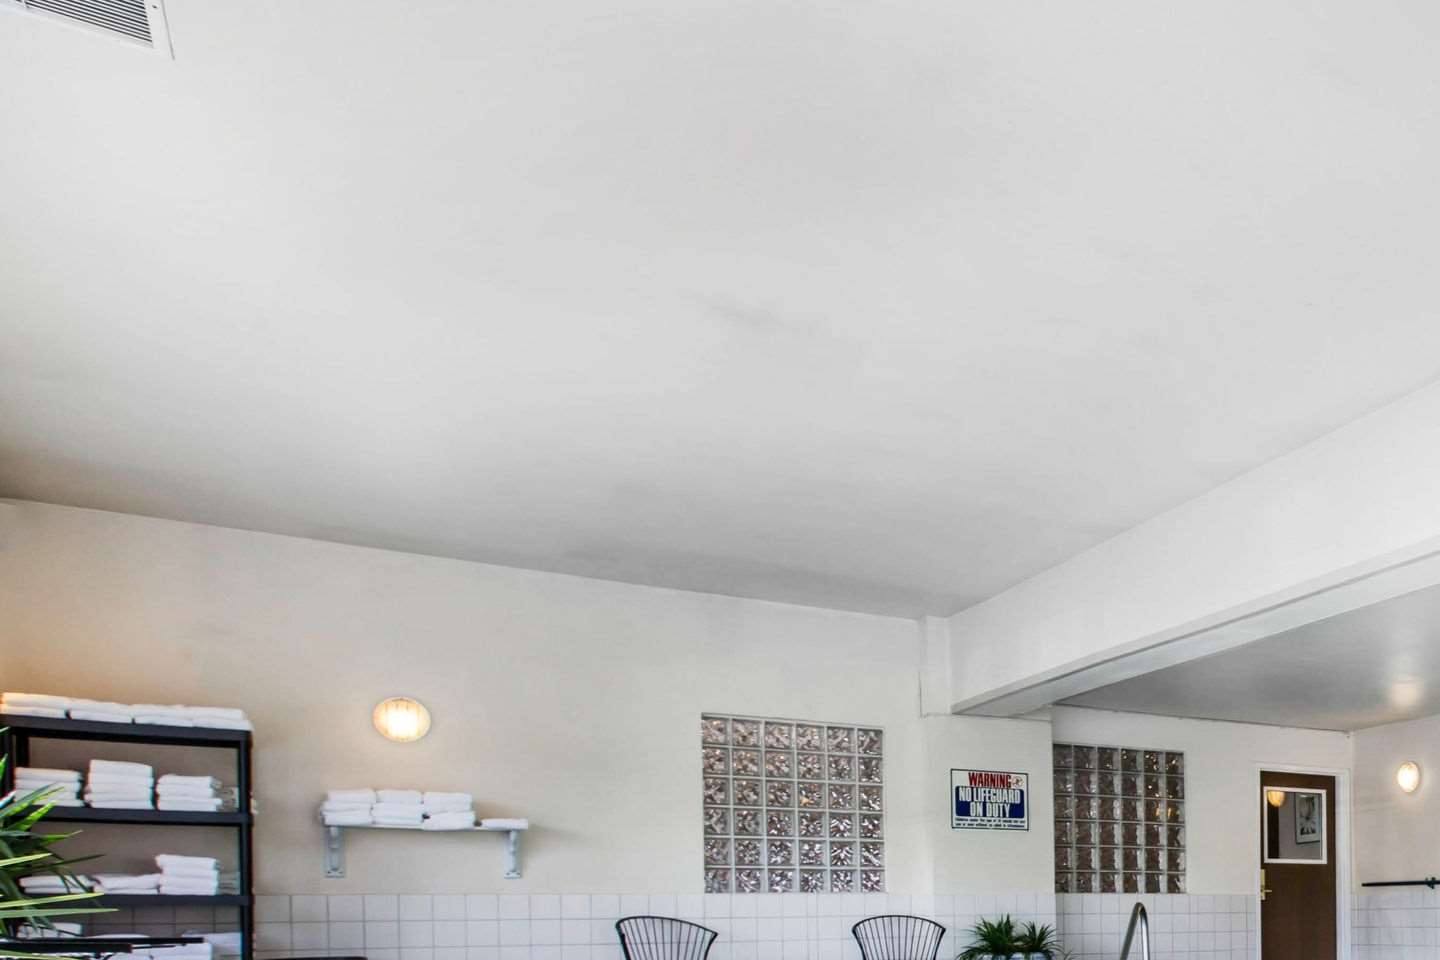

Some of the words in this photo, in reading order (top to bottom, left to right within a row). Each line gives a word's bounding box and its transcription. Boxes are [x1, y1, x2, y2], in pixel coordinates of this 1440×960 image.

[968, 772, 1011, 788] WARNING
[959, 788, 971, 801] NO
[973, 788, 1020, 804] LIFEGUARD
[970, 801, 983, 817] ON
[986, 803, 1010, 818] DUTY
